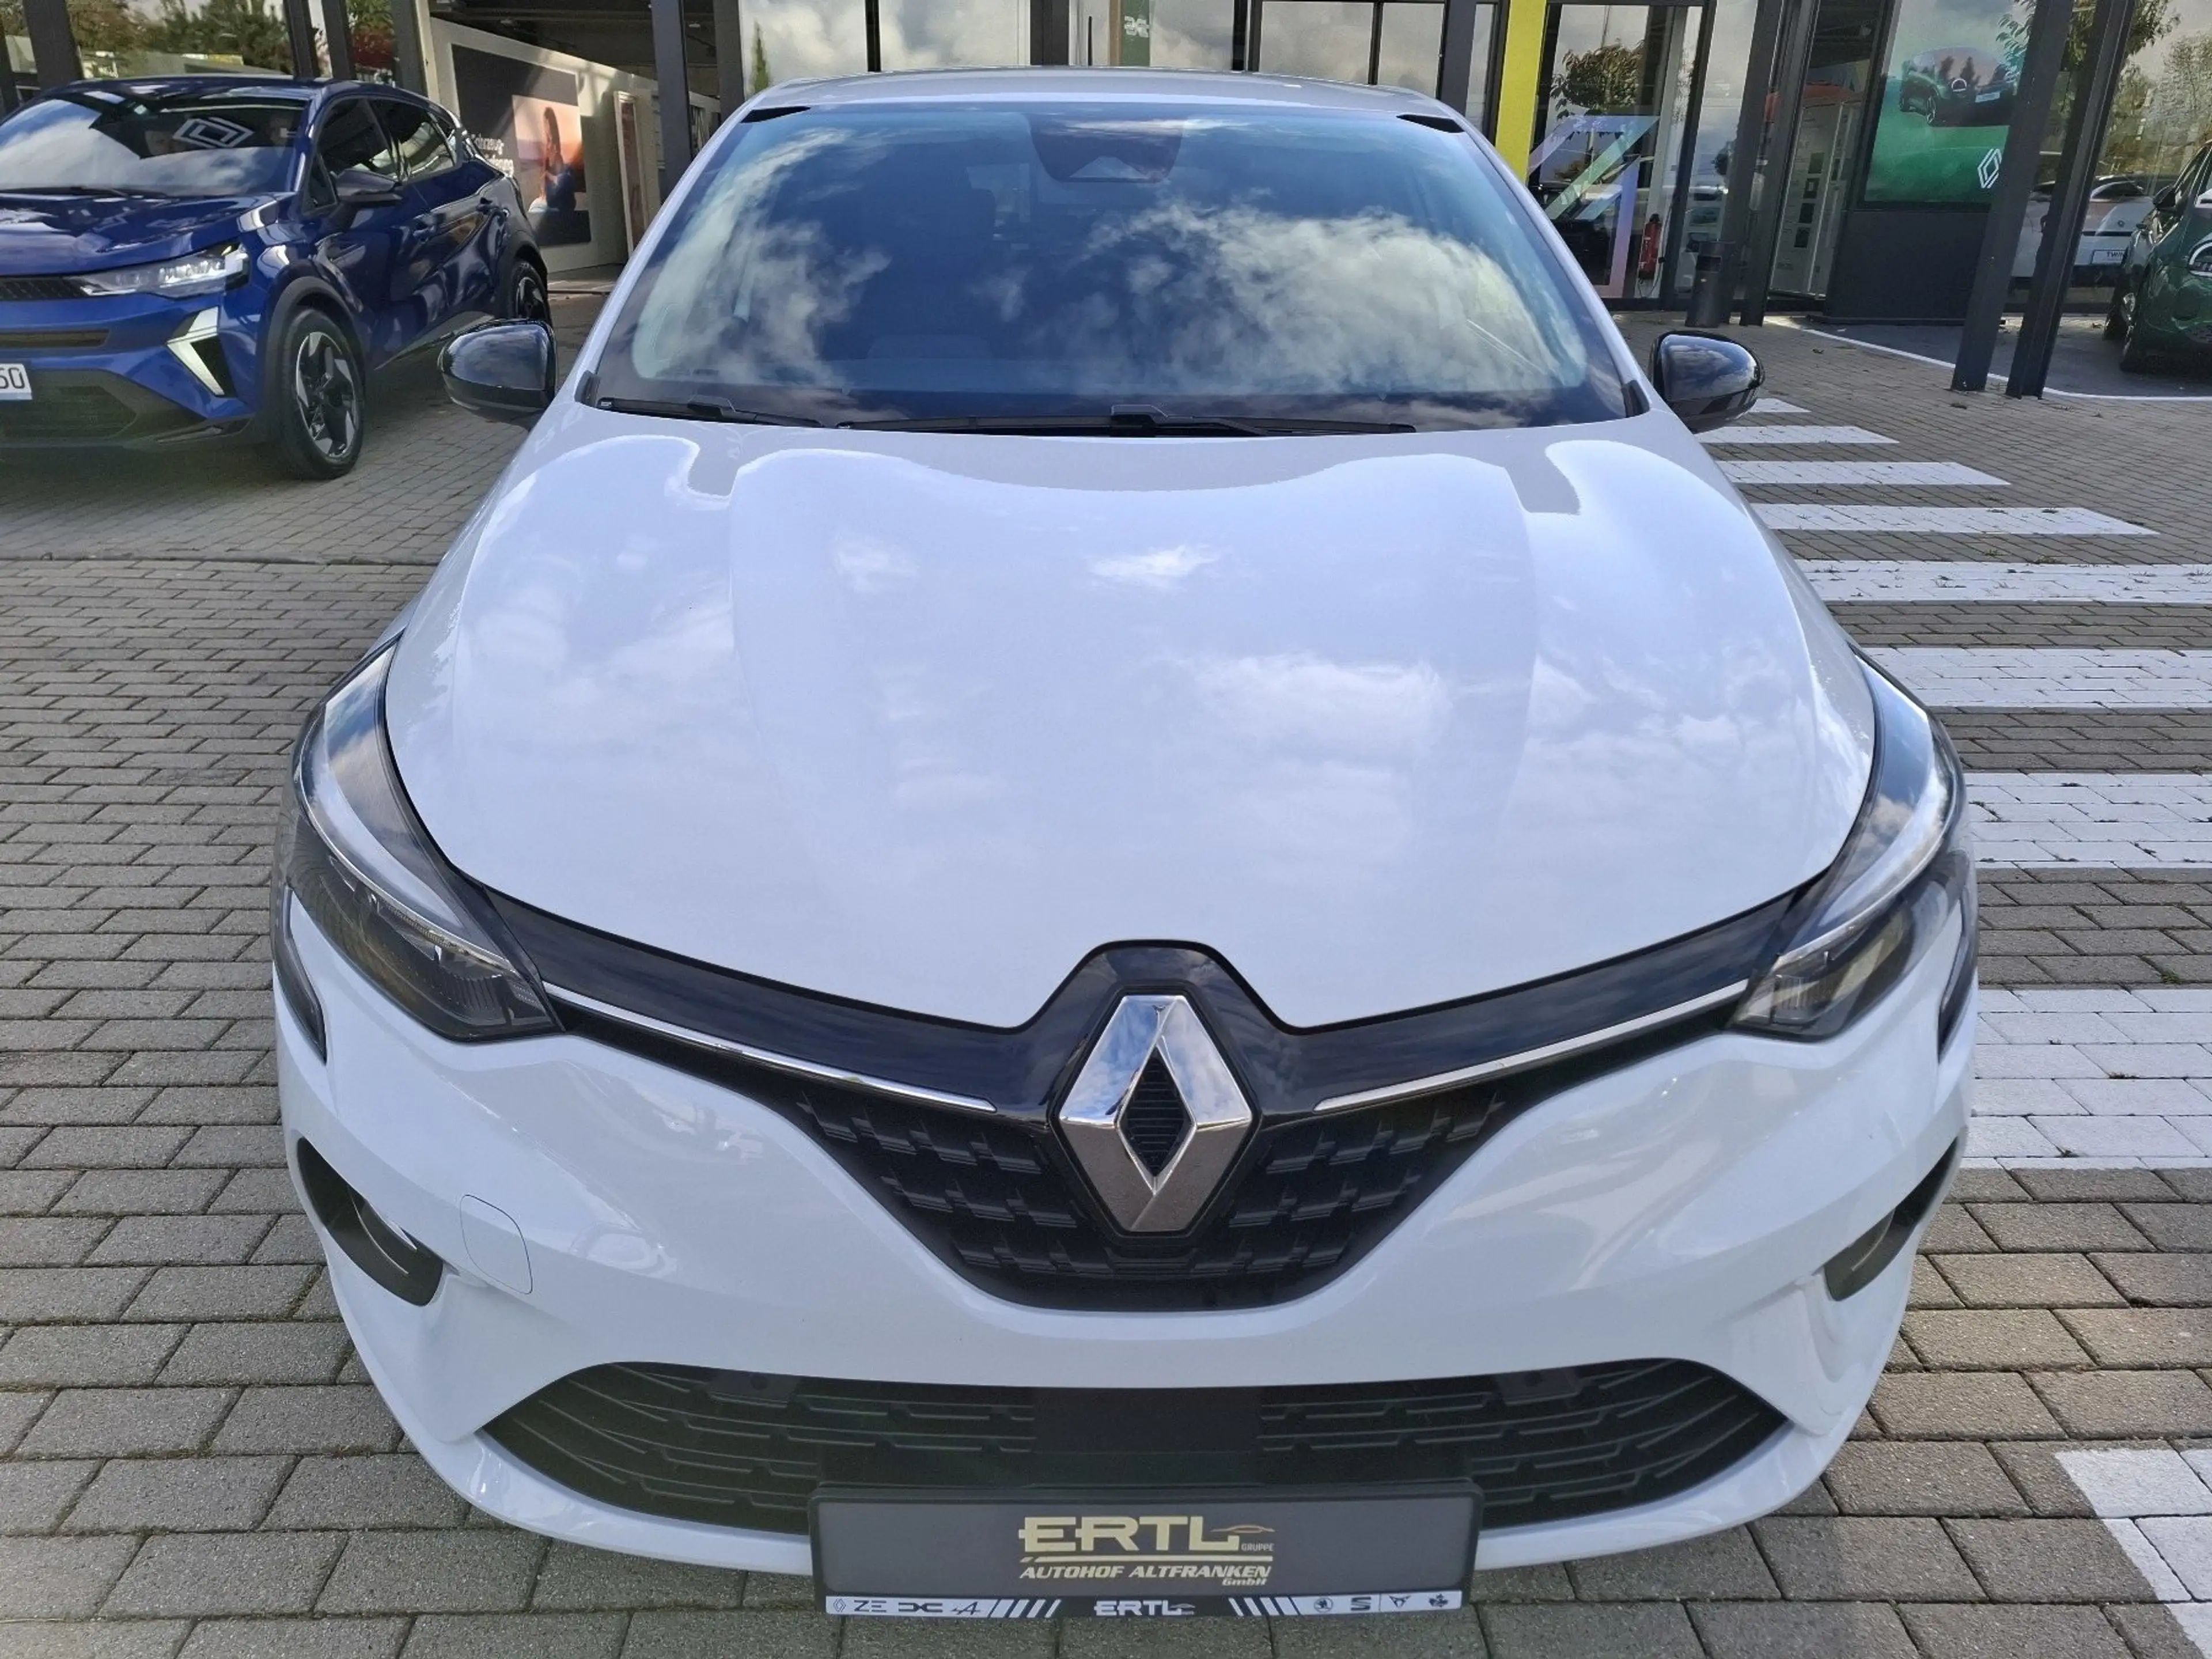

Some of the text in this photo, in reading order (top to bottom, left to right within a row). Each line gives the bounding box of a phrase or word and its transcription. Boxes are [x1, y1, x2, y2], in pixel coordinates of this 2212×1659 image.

[1018, 1516, 1240, 1551] ERTL
[1241, 1543, 1275, 1552] GRUPPE
[1019, 1565, 1272, 1579] AUTOHOF ALTFRANKEN
[1221, 1577, 1267, 1586] GmbH
[1094, 1600, 1182, 1616] ERTL
